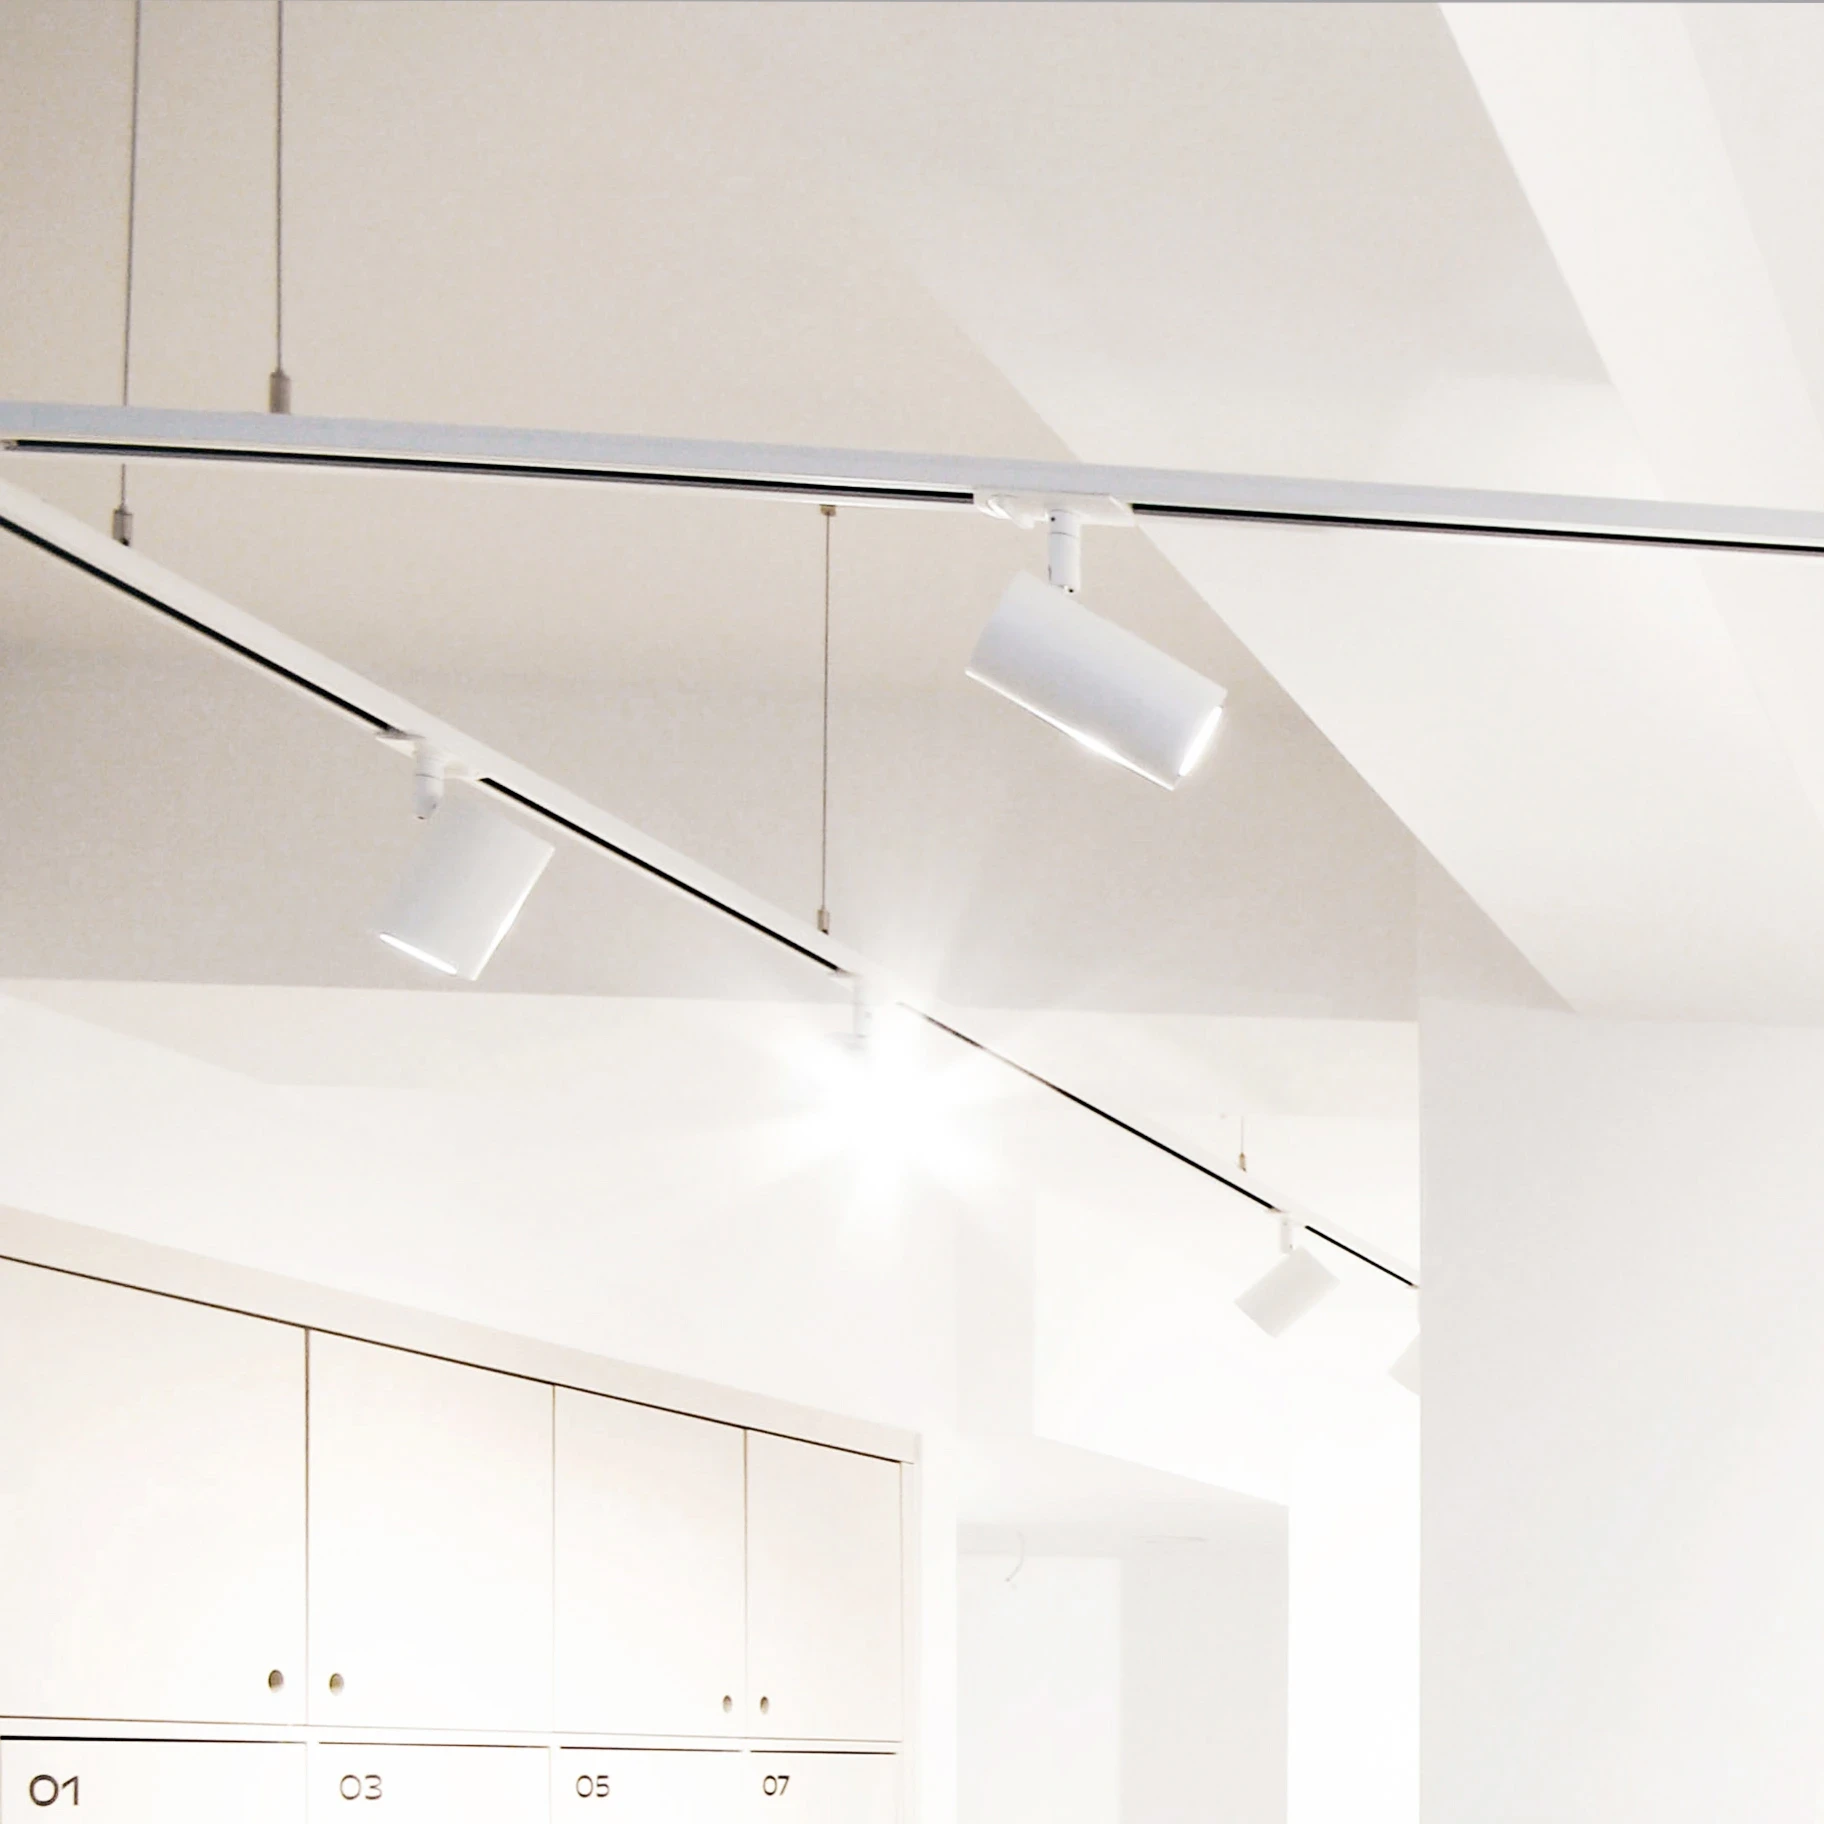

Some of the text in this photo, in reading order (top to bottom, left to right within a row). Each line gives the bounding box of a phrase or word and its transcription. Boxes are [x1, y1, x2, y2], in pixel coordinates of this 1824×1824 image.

[28, 1773, 79, 1807] 01
[338, 1774, 383, 1801] 03
[575, 1774, 611, 1799] 05
[762, 1774, 790, 1797] 07
